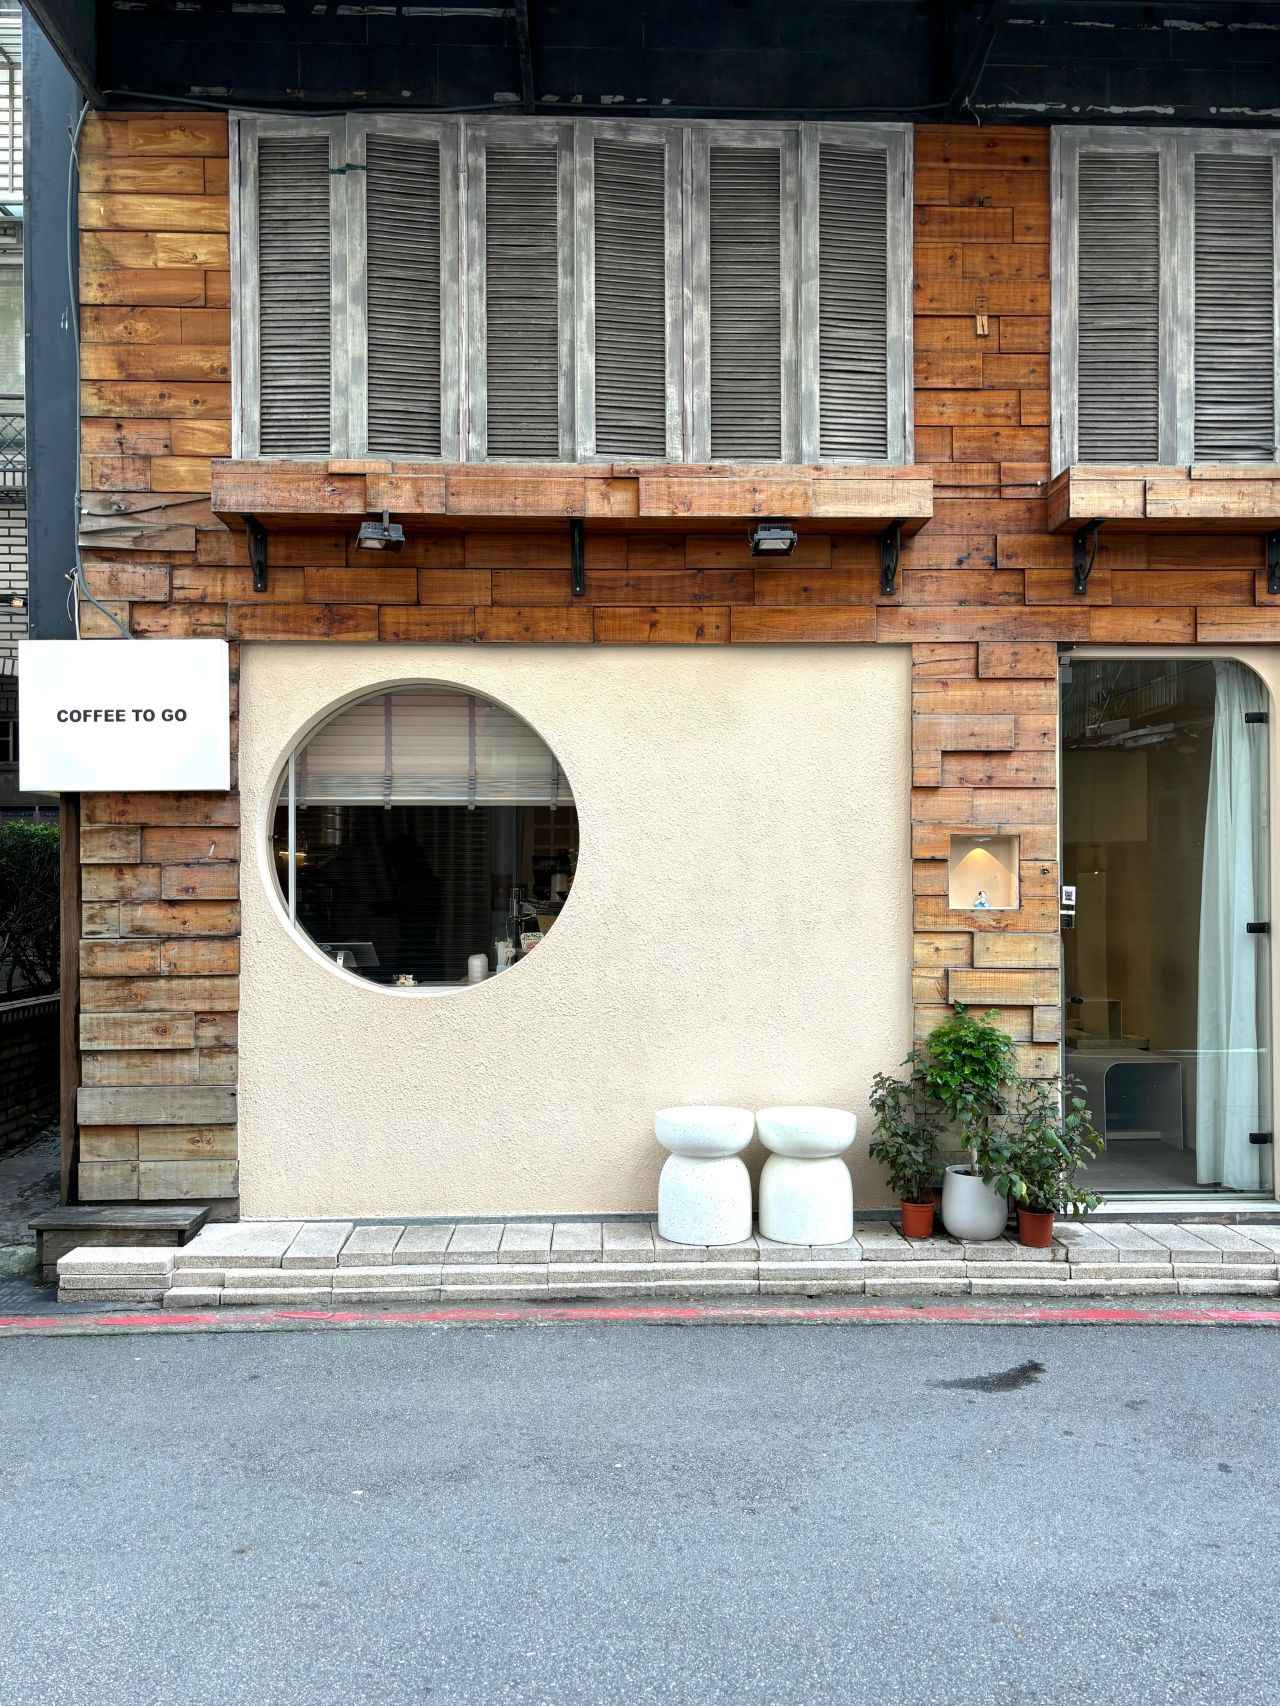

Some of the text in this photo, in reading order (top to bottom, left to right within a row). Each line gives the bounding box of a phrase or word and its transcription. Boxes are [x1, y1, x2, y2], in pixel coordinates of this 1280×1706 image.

[57, 708, 187, 722] COFFEE TO GO
